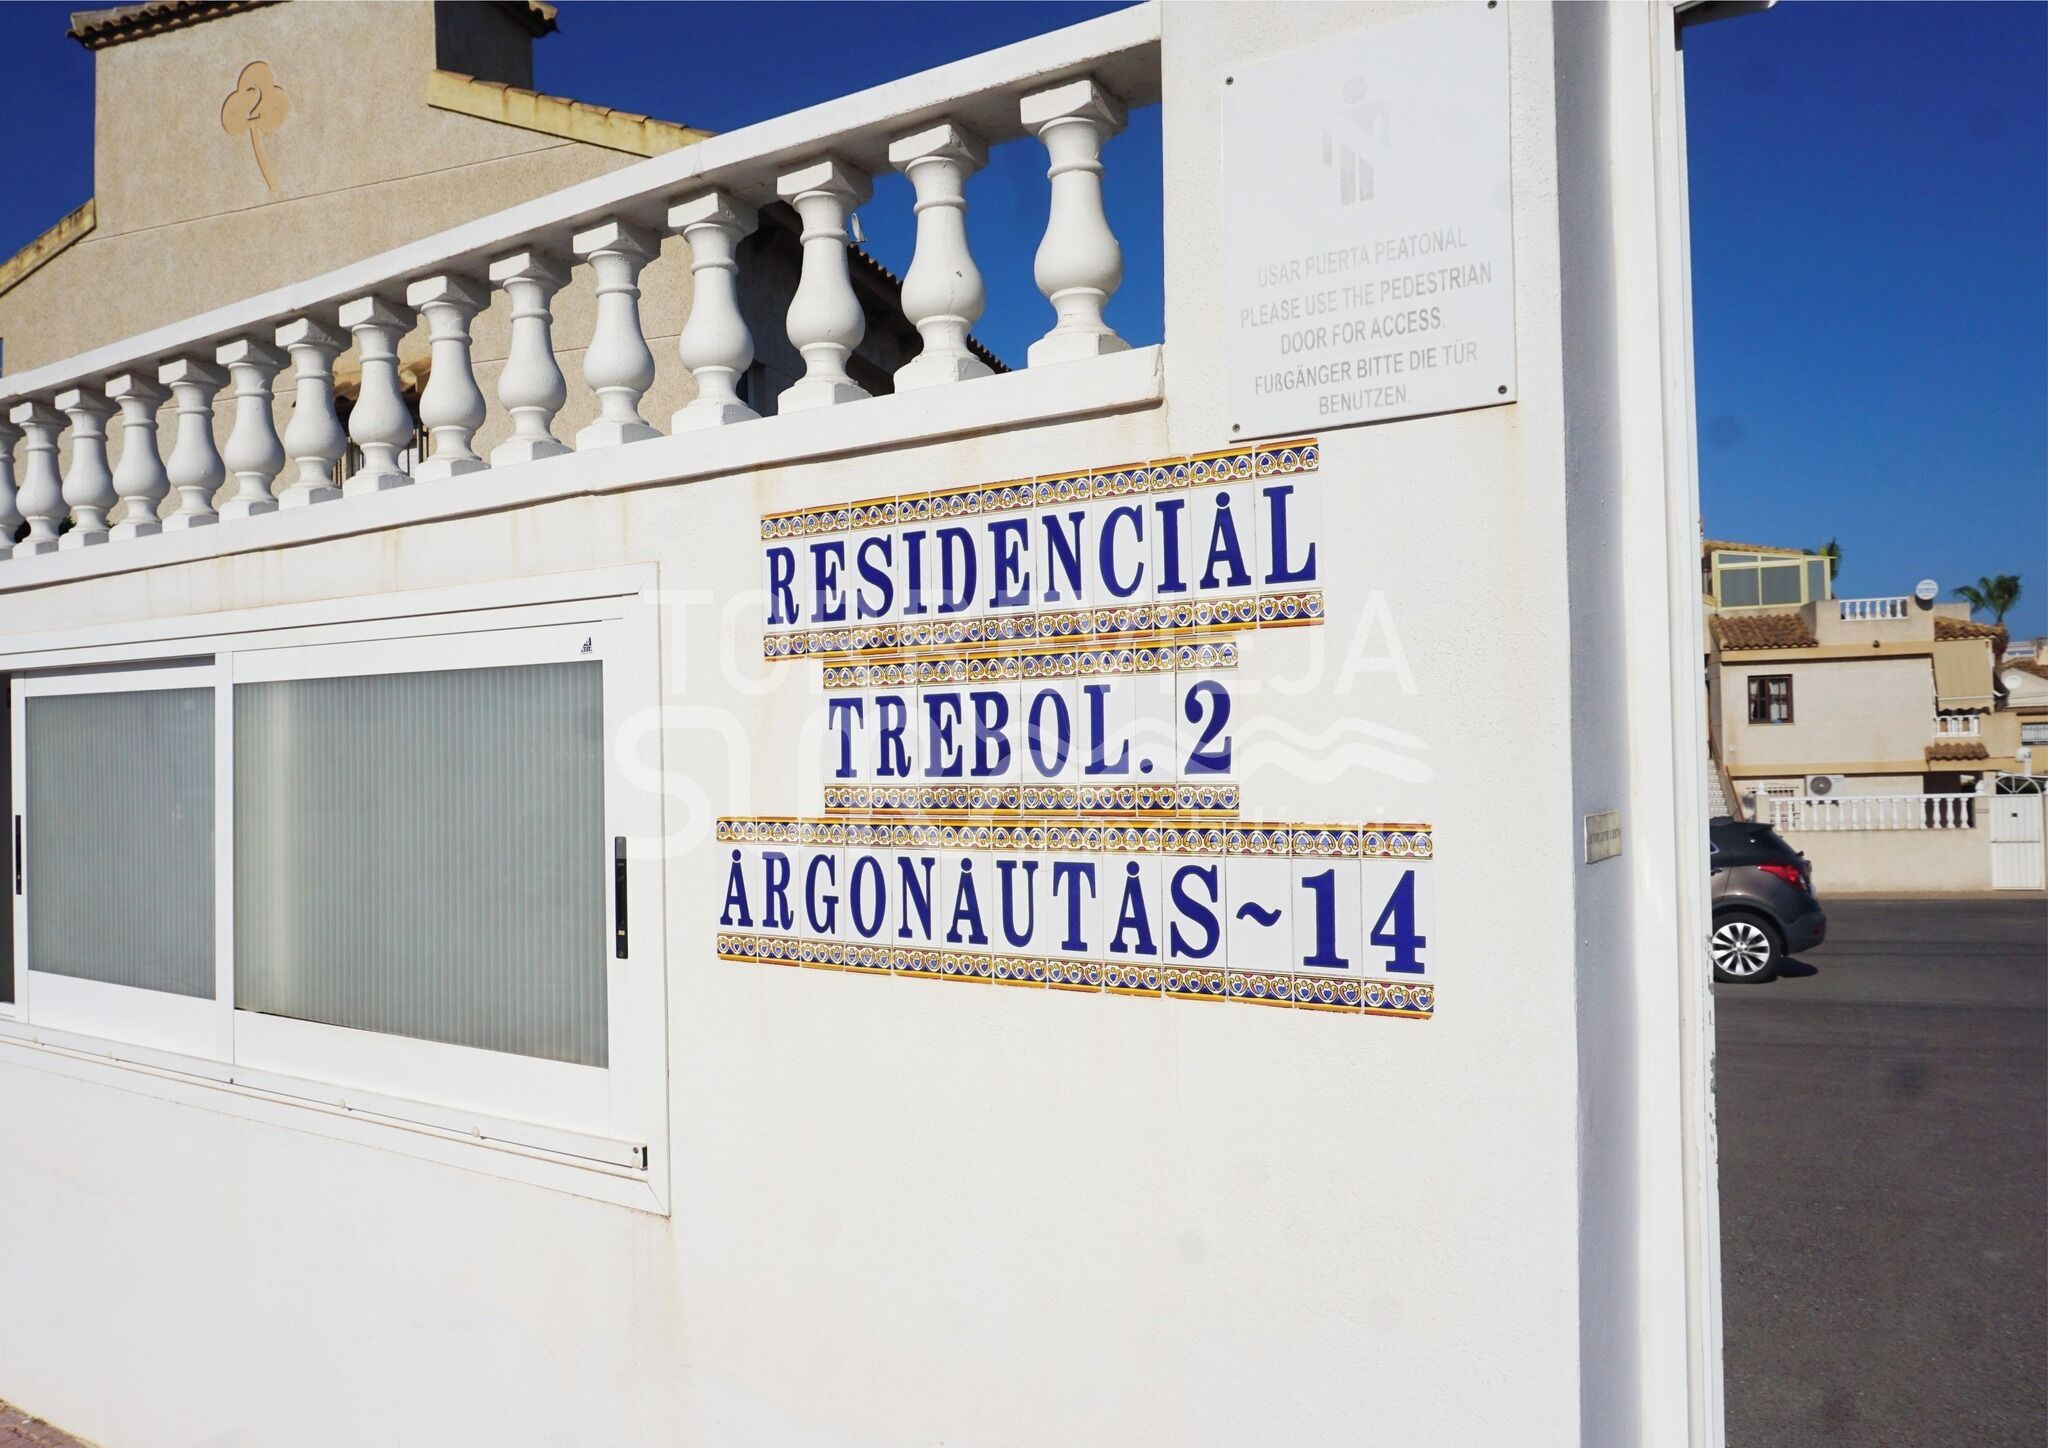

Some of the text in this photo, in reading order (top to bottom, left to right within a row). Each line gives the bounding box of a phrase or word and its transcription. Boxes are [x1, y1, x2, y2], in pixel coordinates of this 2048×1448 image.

[246, 85, 262, 121] 2
[1257, 228, 1467, 288] USAR PUERTA PEATONAL
[1241, 262, 1491, 328] PLEASE USE THE PEDESTRIAN
[1281, 327, 1326, 355] DOOR
[1332, 321, 1366, 346] FOR
[1356, 352, 1403, 380] BITTE
[1409, 347, 1437, 371] DIE
[1442, 338, 1479, 366] TÜR
